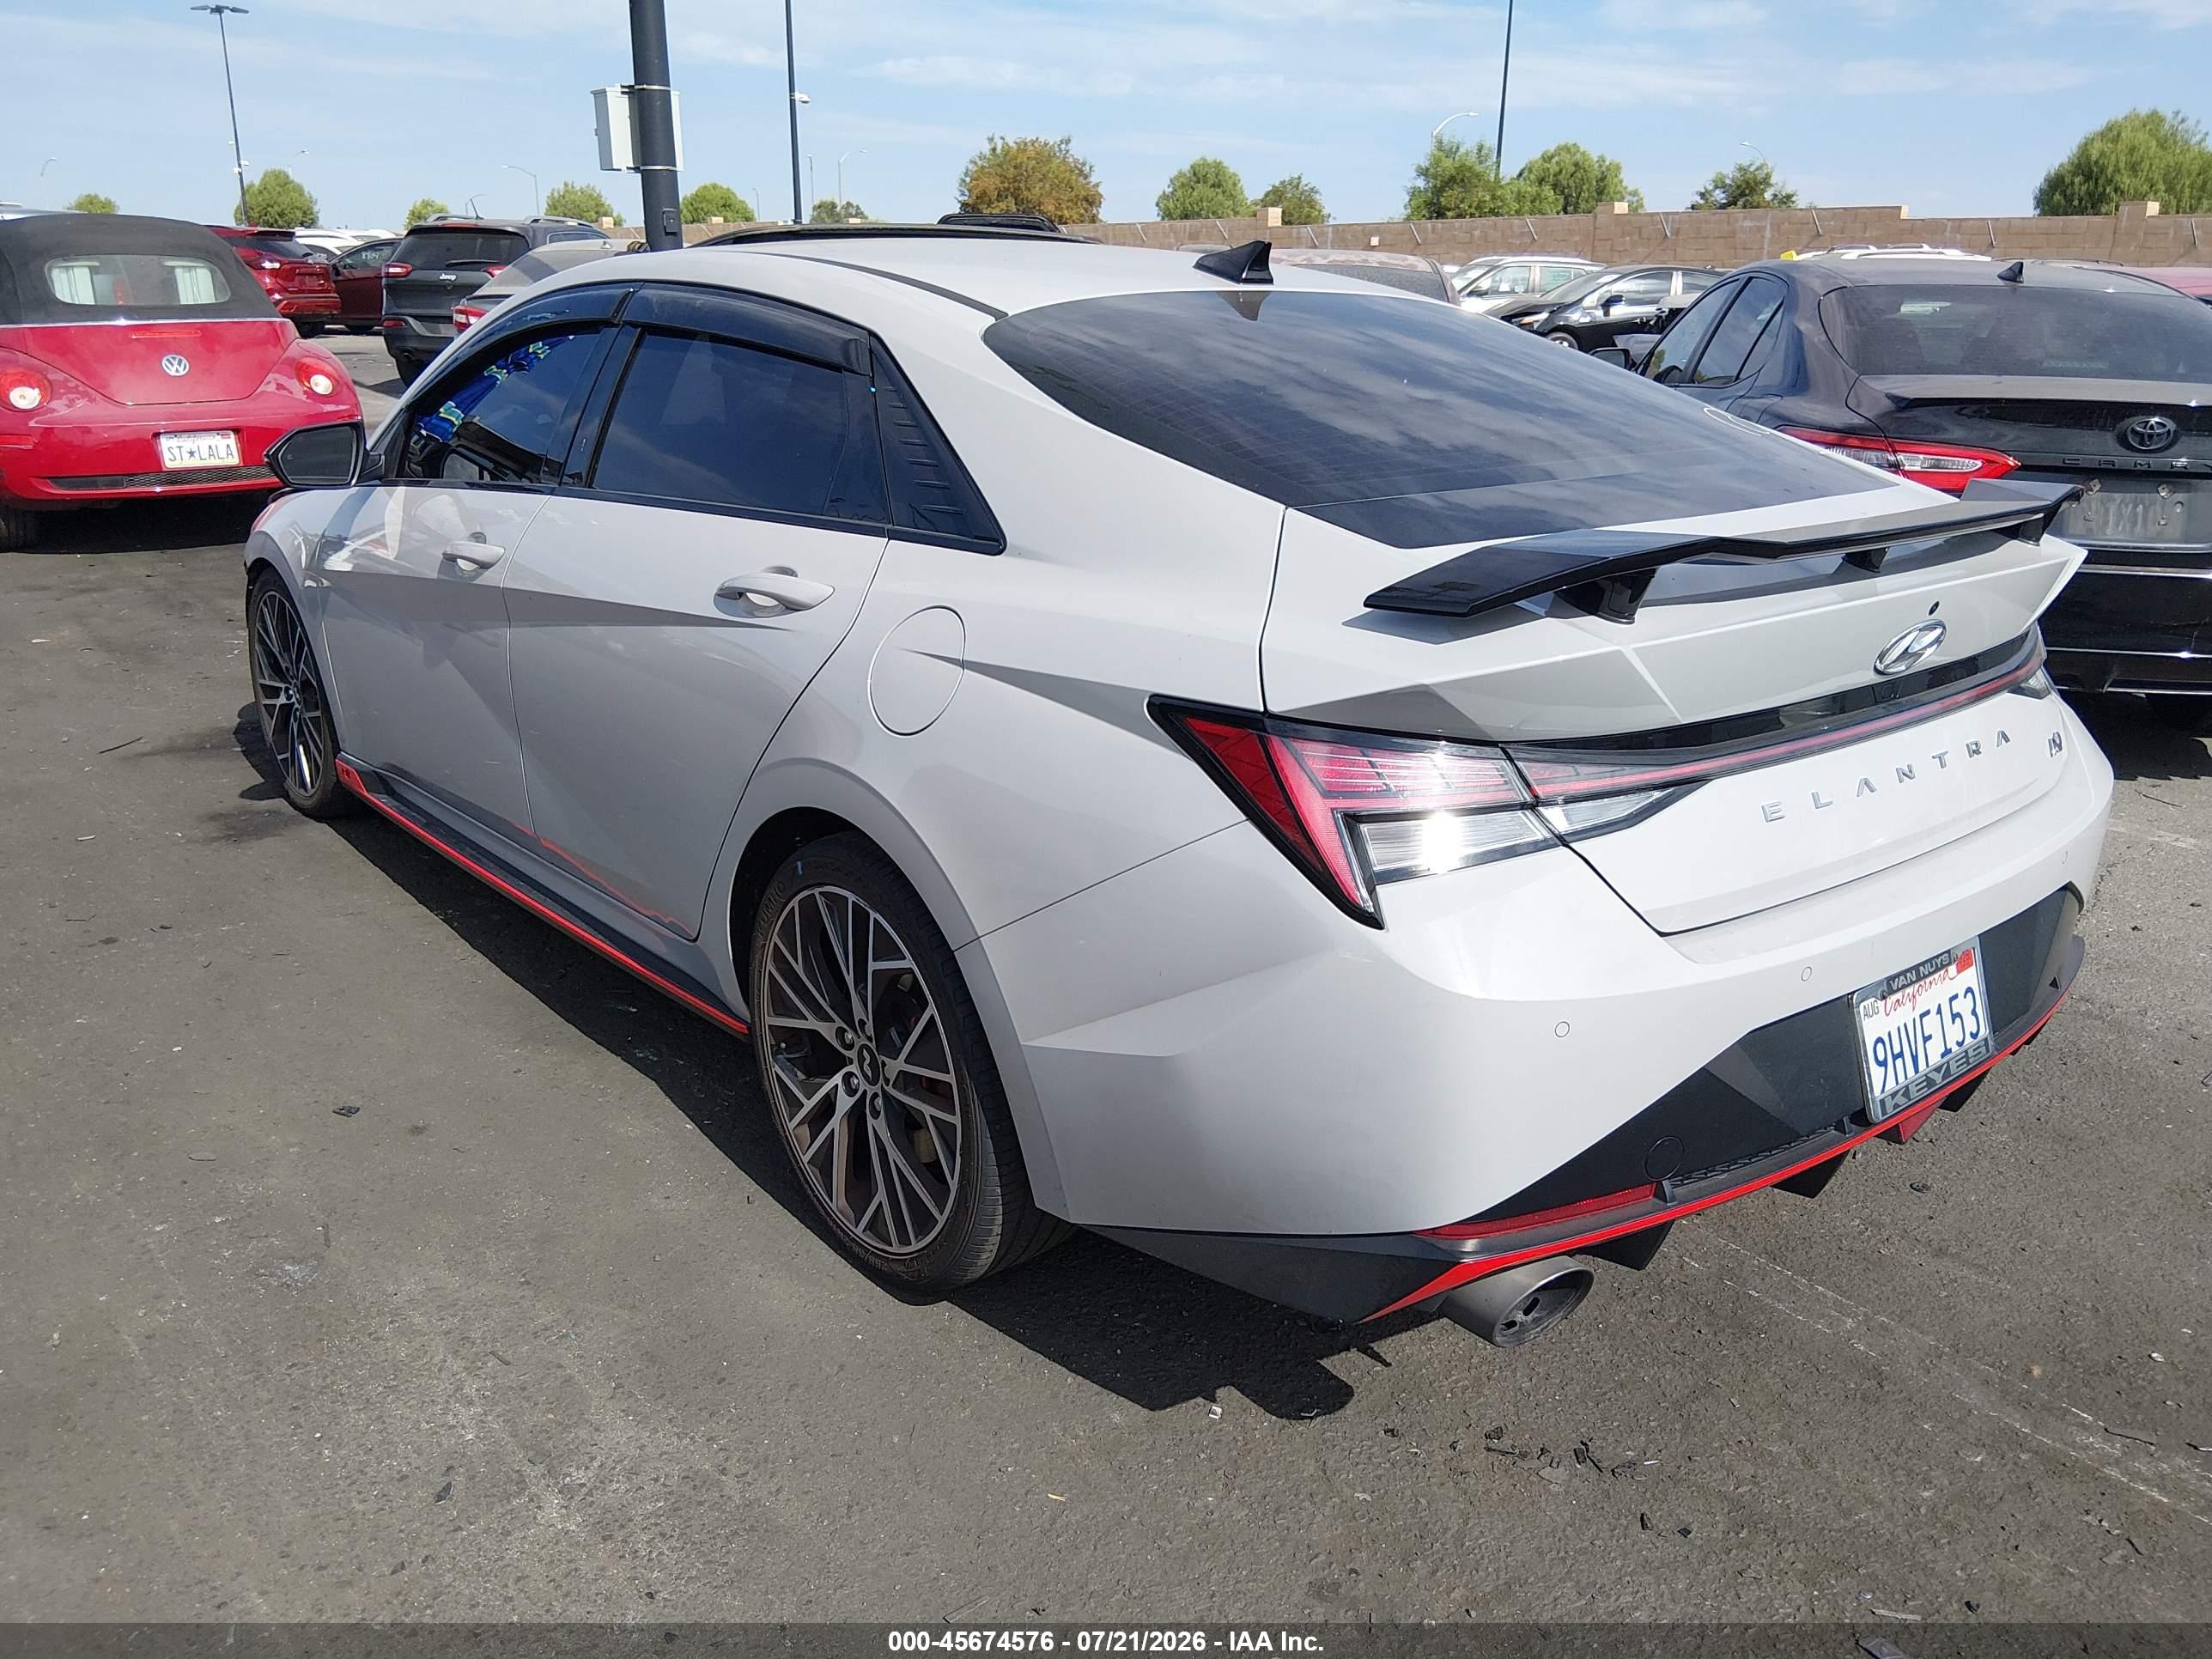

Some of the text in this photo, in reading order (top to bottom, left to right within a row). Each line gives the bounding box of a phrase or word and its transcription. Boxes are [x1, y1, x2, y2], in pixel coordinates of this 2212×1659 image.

[1761, 729, 2011, 823] ELANTRA
[1883, 967, 1955, 1017] California
[1890, 970, 1917, 988] VAN
[1920, 953, 1950, 977] NUYS
[1863, 1000, 1880, 1021] AUG
[1873, 987, 1981, 1095] 9HVF153
[1884, 1042, 1988, 1111] KEYES
